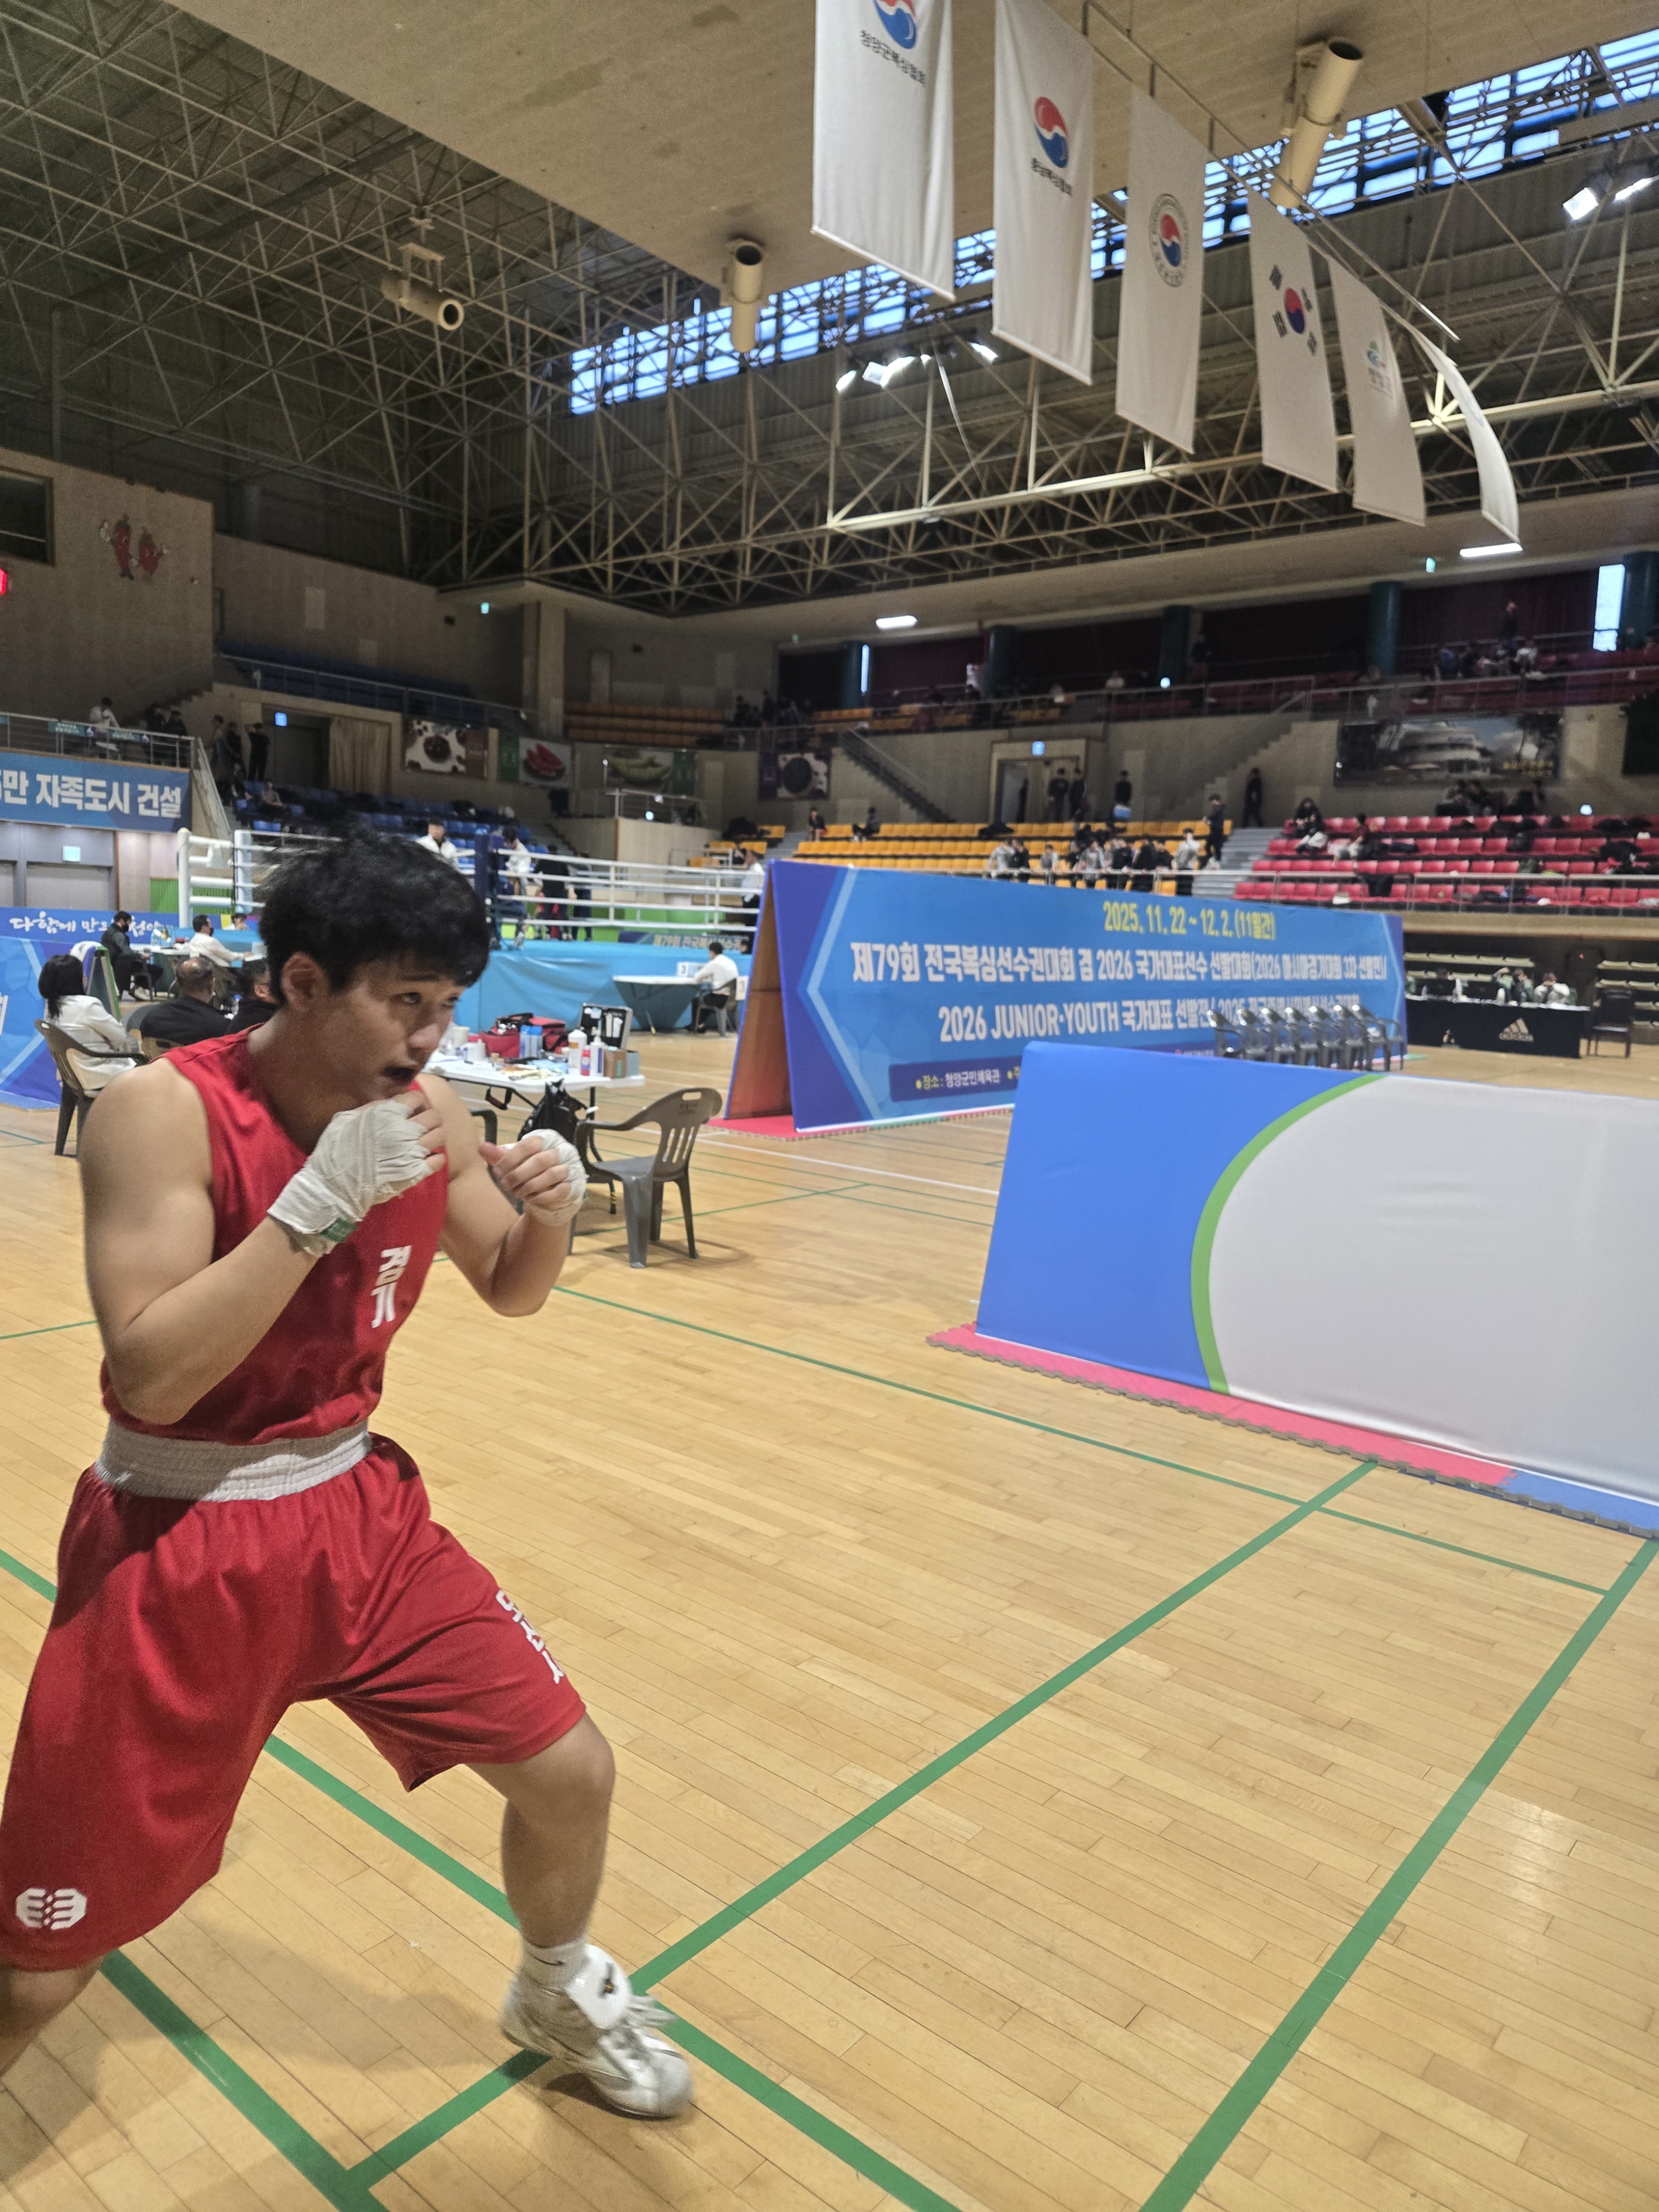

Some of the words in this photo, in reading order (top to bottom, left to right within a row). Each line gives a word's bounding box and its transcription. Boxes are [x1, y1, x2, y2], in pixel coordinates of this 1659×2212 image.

[0, 770, 28, 805] 만
[36, 774, 130, 814] 자족도시
[138, 784, 181, 818] 건설
[9, 911, 76, 933] 다함께
[81, 917, 114, 933] 만드
[1103, 901, 1143, 933] 2025.
[1146, 904, 1167, 935] 11.
[1169, 905, 1186, 935] 22
[1200, 908, 1219, 936] 12.
[850, 941, 921, 982] 제79회
[924, 943, 1076, 983] 전국복싱선수권대회
[1078, 947, 1093, 982] 겸
[1096, 950, 1133, 980] 2026
[1135, 949, 1207, 981] 국가대표선수
[938, 1005, 988, 1042] 2026
[990, 1001, 1120, 1039] JUNIOR·YOUTH
[1121, 999, 1173, 1031] 국가대표
